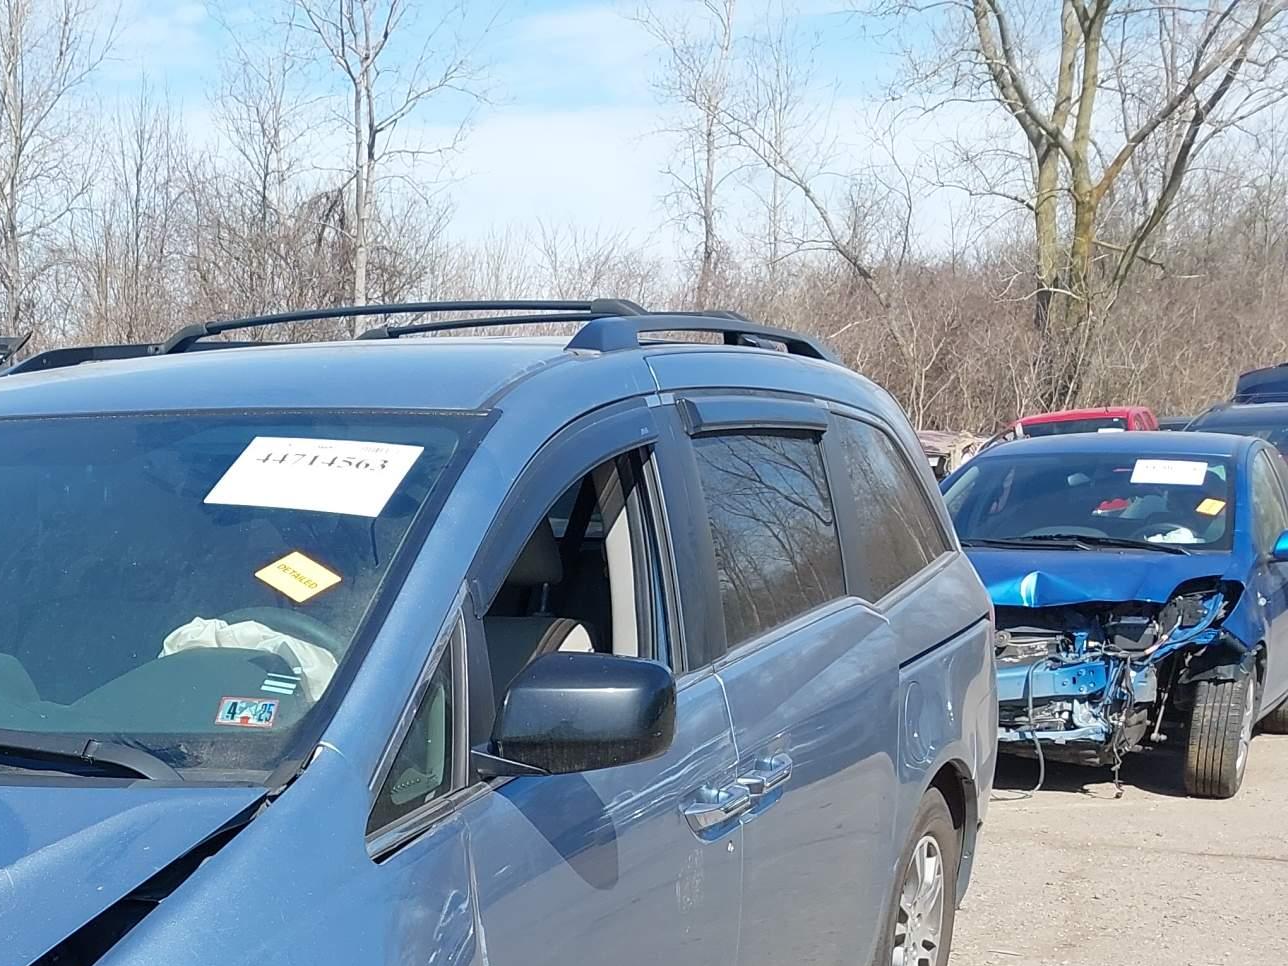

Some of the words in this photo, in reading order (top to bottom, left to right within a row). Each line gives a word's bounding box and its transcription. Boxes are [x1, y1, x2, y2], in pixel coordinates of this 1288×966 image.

[256, 452, 389, 471] 44714563
[277, 563, 318, 589] DETAILED
[257, 703, 275, 722] 25
